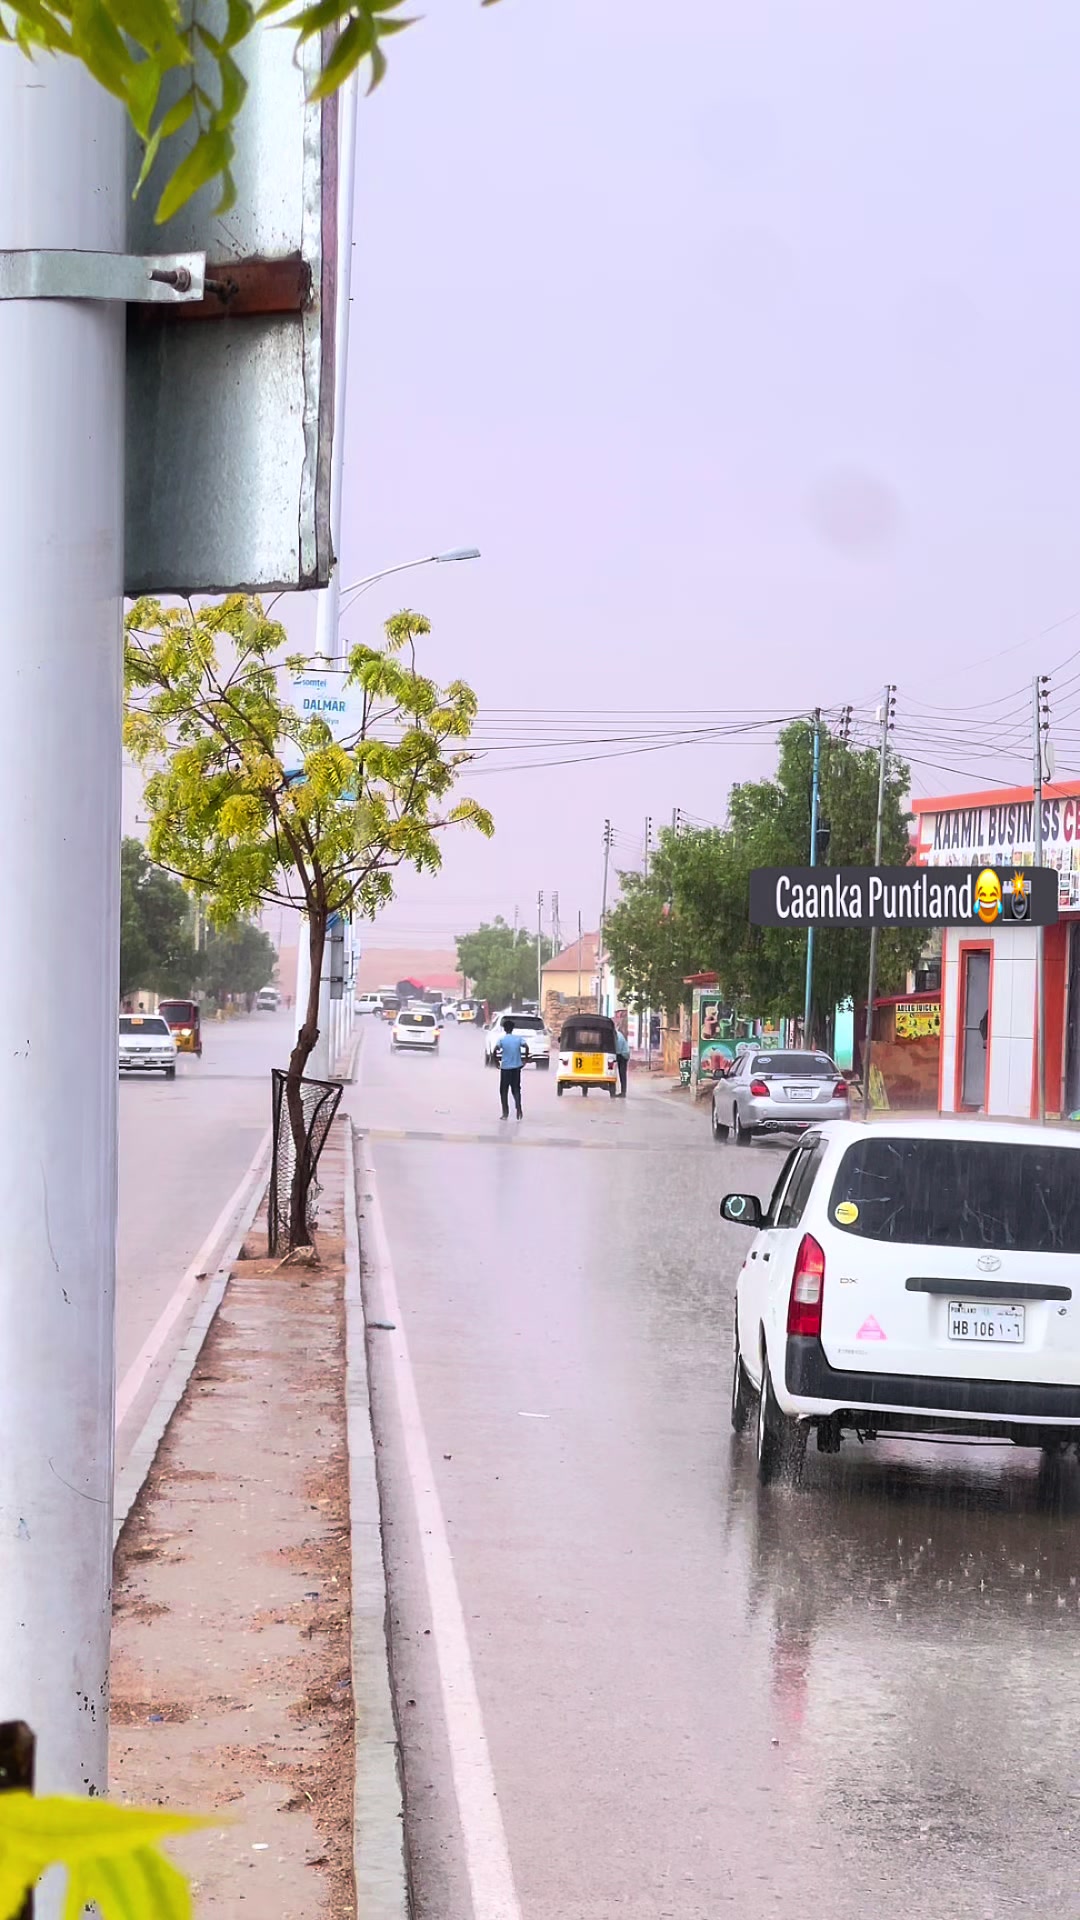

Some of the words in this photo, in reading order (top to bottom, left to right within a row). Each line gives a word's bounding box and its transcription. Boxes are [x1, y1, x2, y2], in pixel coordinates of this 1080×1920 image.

[303, 699, 346, 711] DALMAR
[934, 809, 984, 850] KAAMIL
[953, 1320, 968, 1335] HB
[974, 1321, 994, 1337] 106
